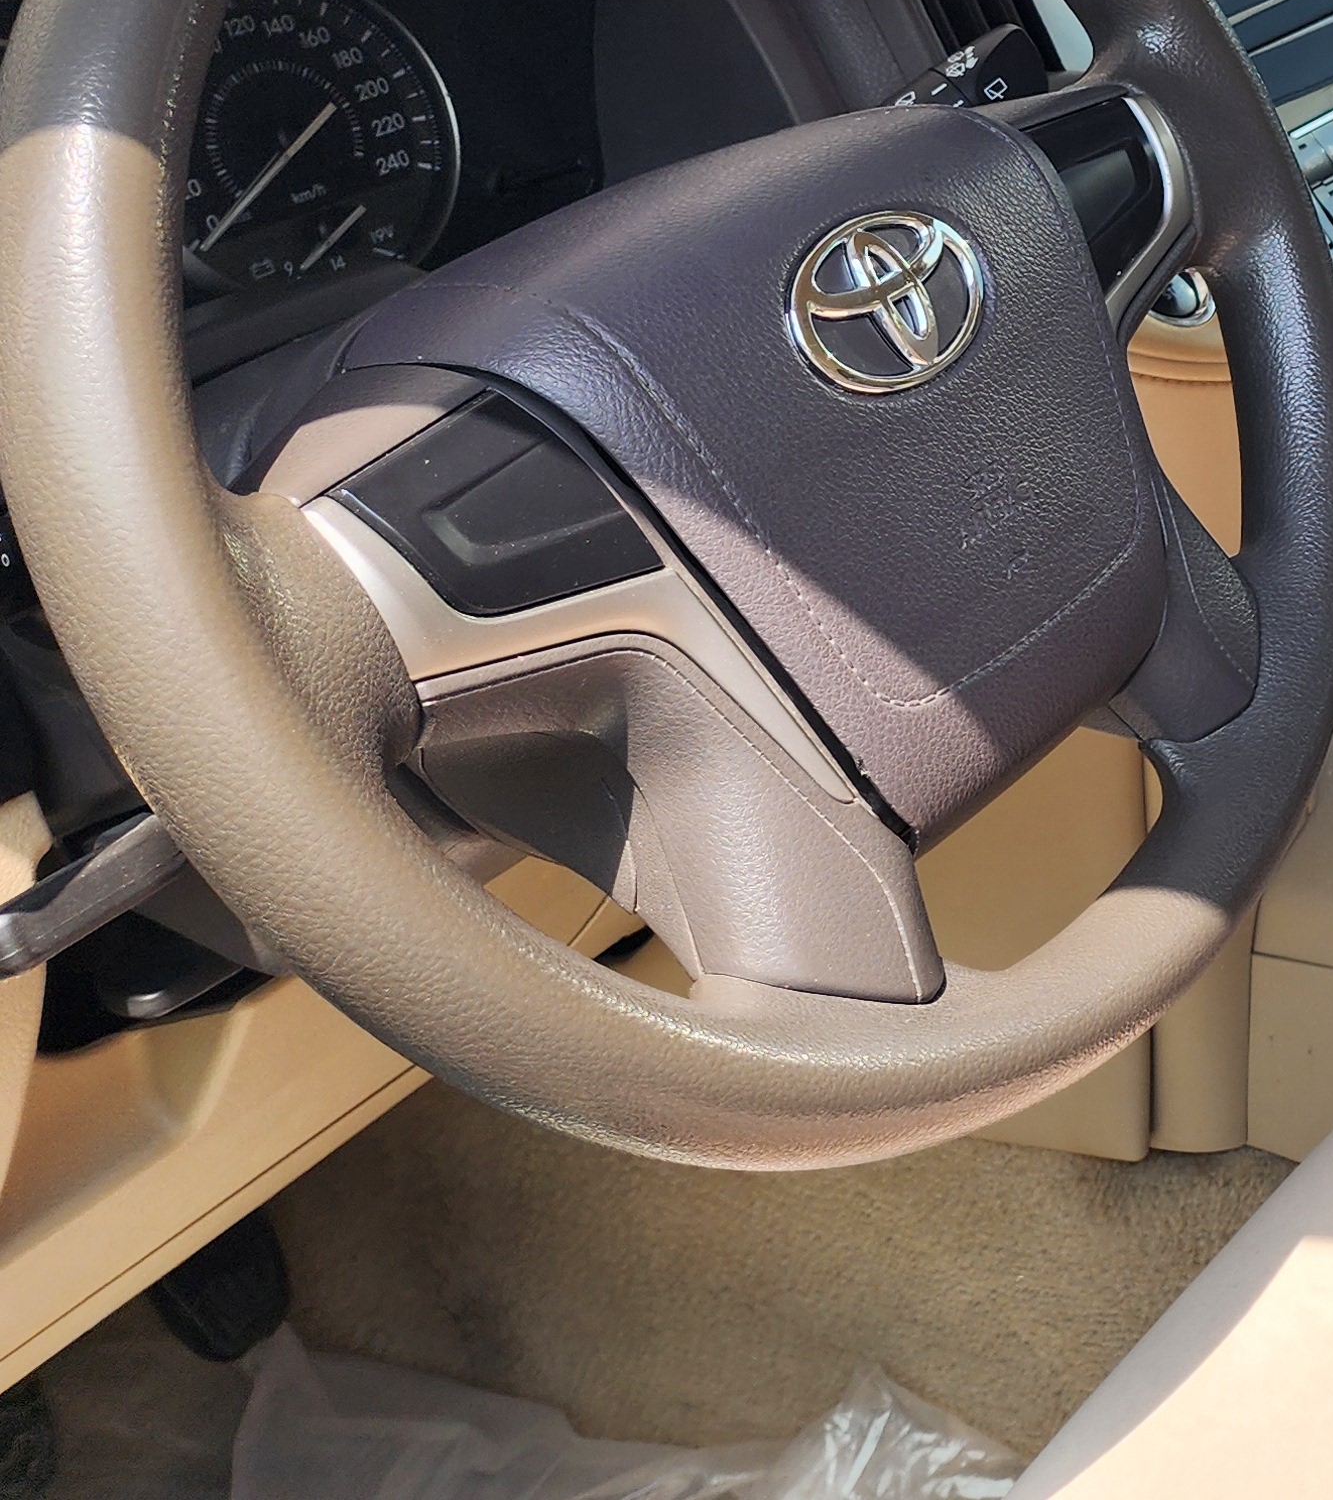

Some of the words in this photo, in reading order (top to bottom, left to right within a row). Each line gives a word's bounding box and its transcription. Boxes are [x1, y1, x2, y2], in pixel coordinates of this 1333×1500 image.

[223, 14, 256, 36] 120
[262, 14, 295, 38] 140
[299, 26, 331, 49] 160
[332, 47, 363, 69] 180
[355, 77, 389, 102] 200
[371, 112, 405, 137] 220
[376, 150, 411, 177] 240
